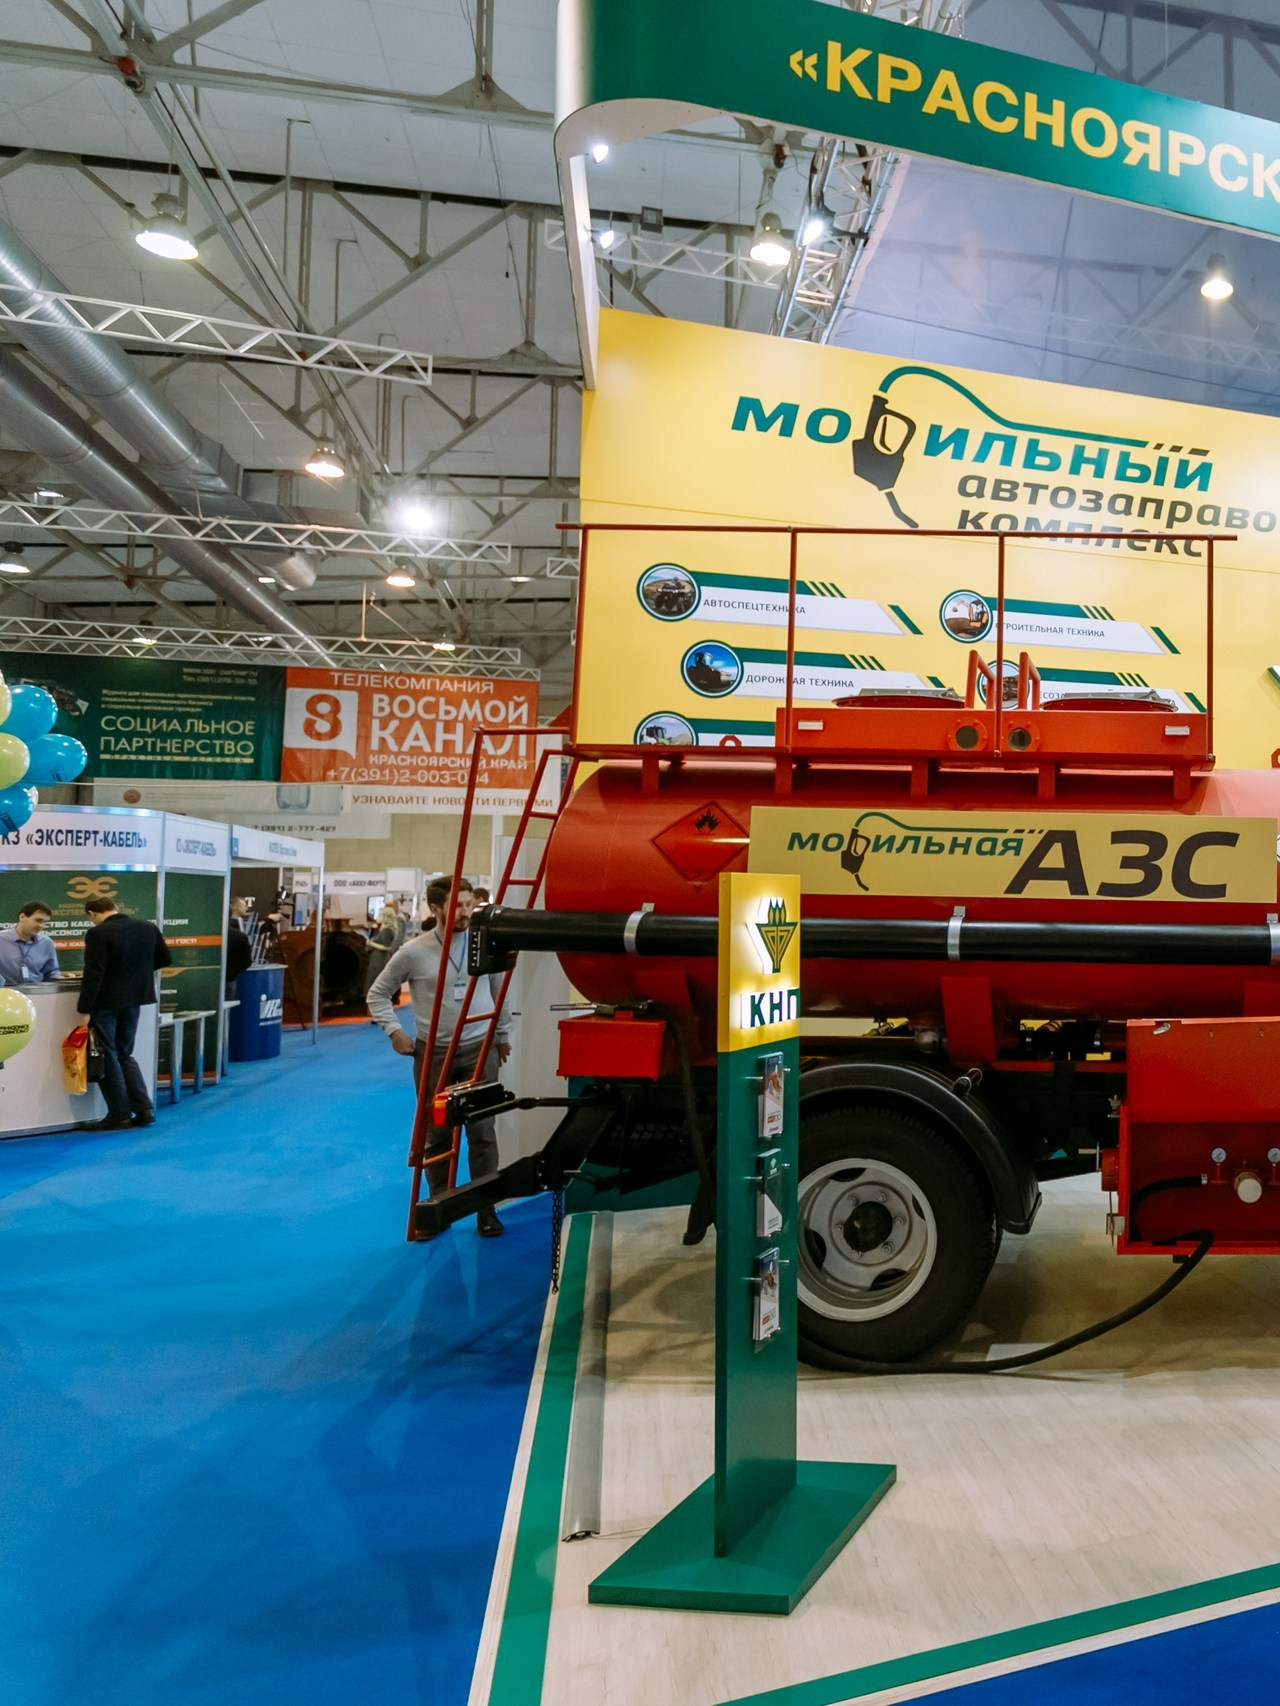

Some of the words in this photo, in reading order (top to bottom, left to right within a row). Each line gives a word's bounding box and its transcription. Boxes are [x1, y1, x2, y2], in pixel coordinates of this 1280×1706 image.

[1066, 627, 1105, 638] ТЕХНИКА
[330, 671, 494, 694] ТЕЛЕКОМПАНИЯ
[745, 674, 806, 686] ДОРОЖАЯ
[808, 677, 855, 688] ТЕХНИКА
[372, 692, 528, 724] ВОСЬМОЙ
[100, 715, 256, 736] СОЦИАЛЬНОЕ
[100, 736, 254, 755] ПАРТНЕРСТВО
[370, 719, 527, 757] КАНАЛ
[490, 757, 528, 771] КРАЙ
[327, 767, 490, 785] +7(391)2-003-04
[352, 794, 430, 806] УЗНАВАЙТЕ
[432, 796, 490, 807] НОВОТИ
[493, 797, 553, 808] ПЕРВМИ
[26, 828, 148, 848] «ЭКСПЕРТ-КАБЕЛЬ»
[1003, 828, 1240, 899] АЗС
[746, 986, 800, 1028] КНП
